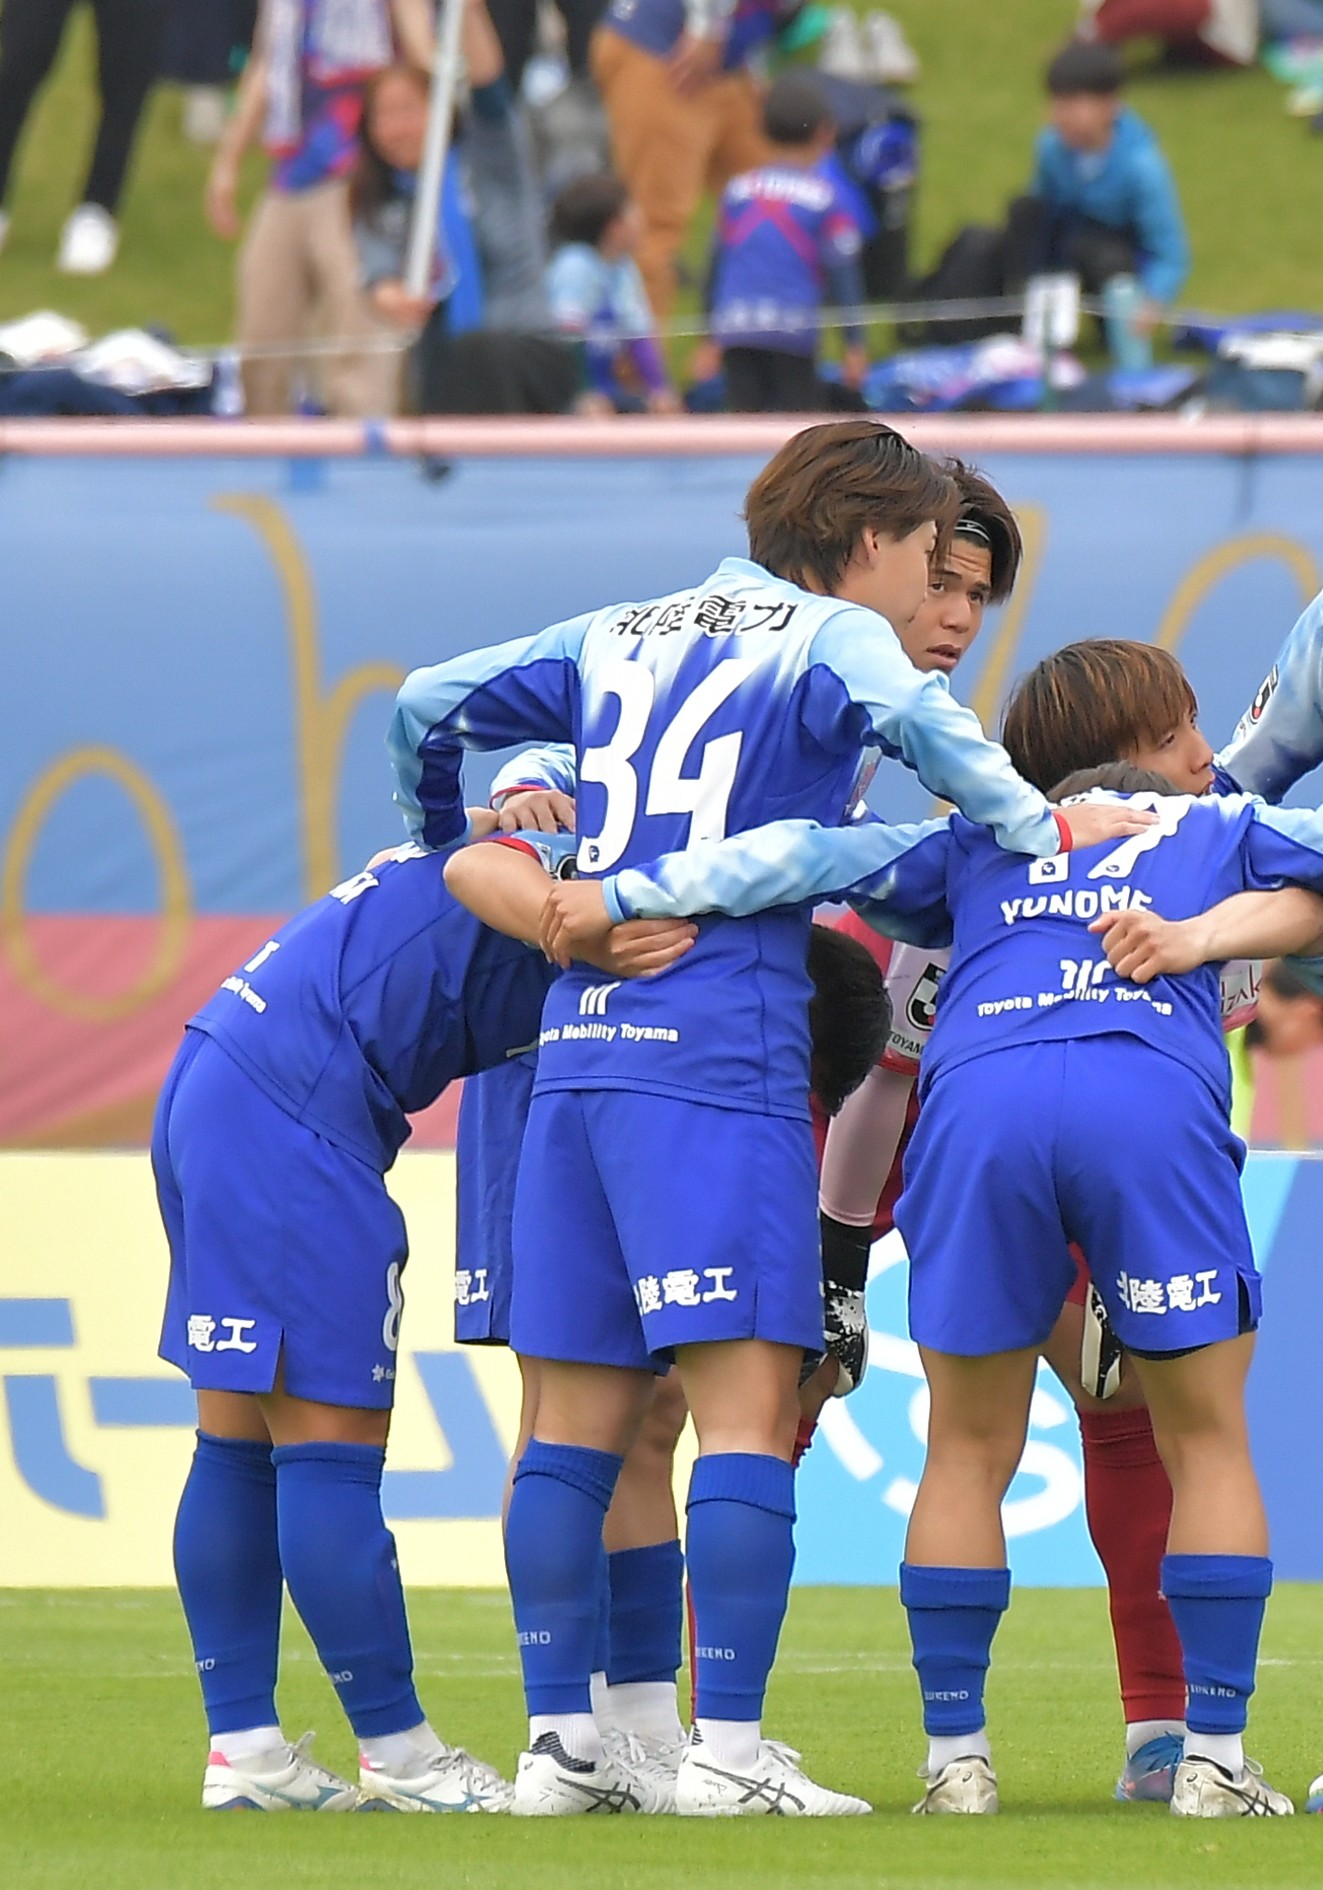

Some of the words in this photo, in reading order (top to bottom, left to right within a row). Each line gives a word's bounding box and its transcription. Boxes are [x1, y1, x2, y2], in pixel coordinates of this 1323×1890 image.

[576, 657, 763, 874] 34
[977, 993, 1033, 1018] Toyota
[561, 1022, 617, 1043] Mobility
[620, 1022, 679, 1042] Toyama
[631, 1266, 738, 1318] 陸電工
